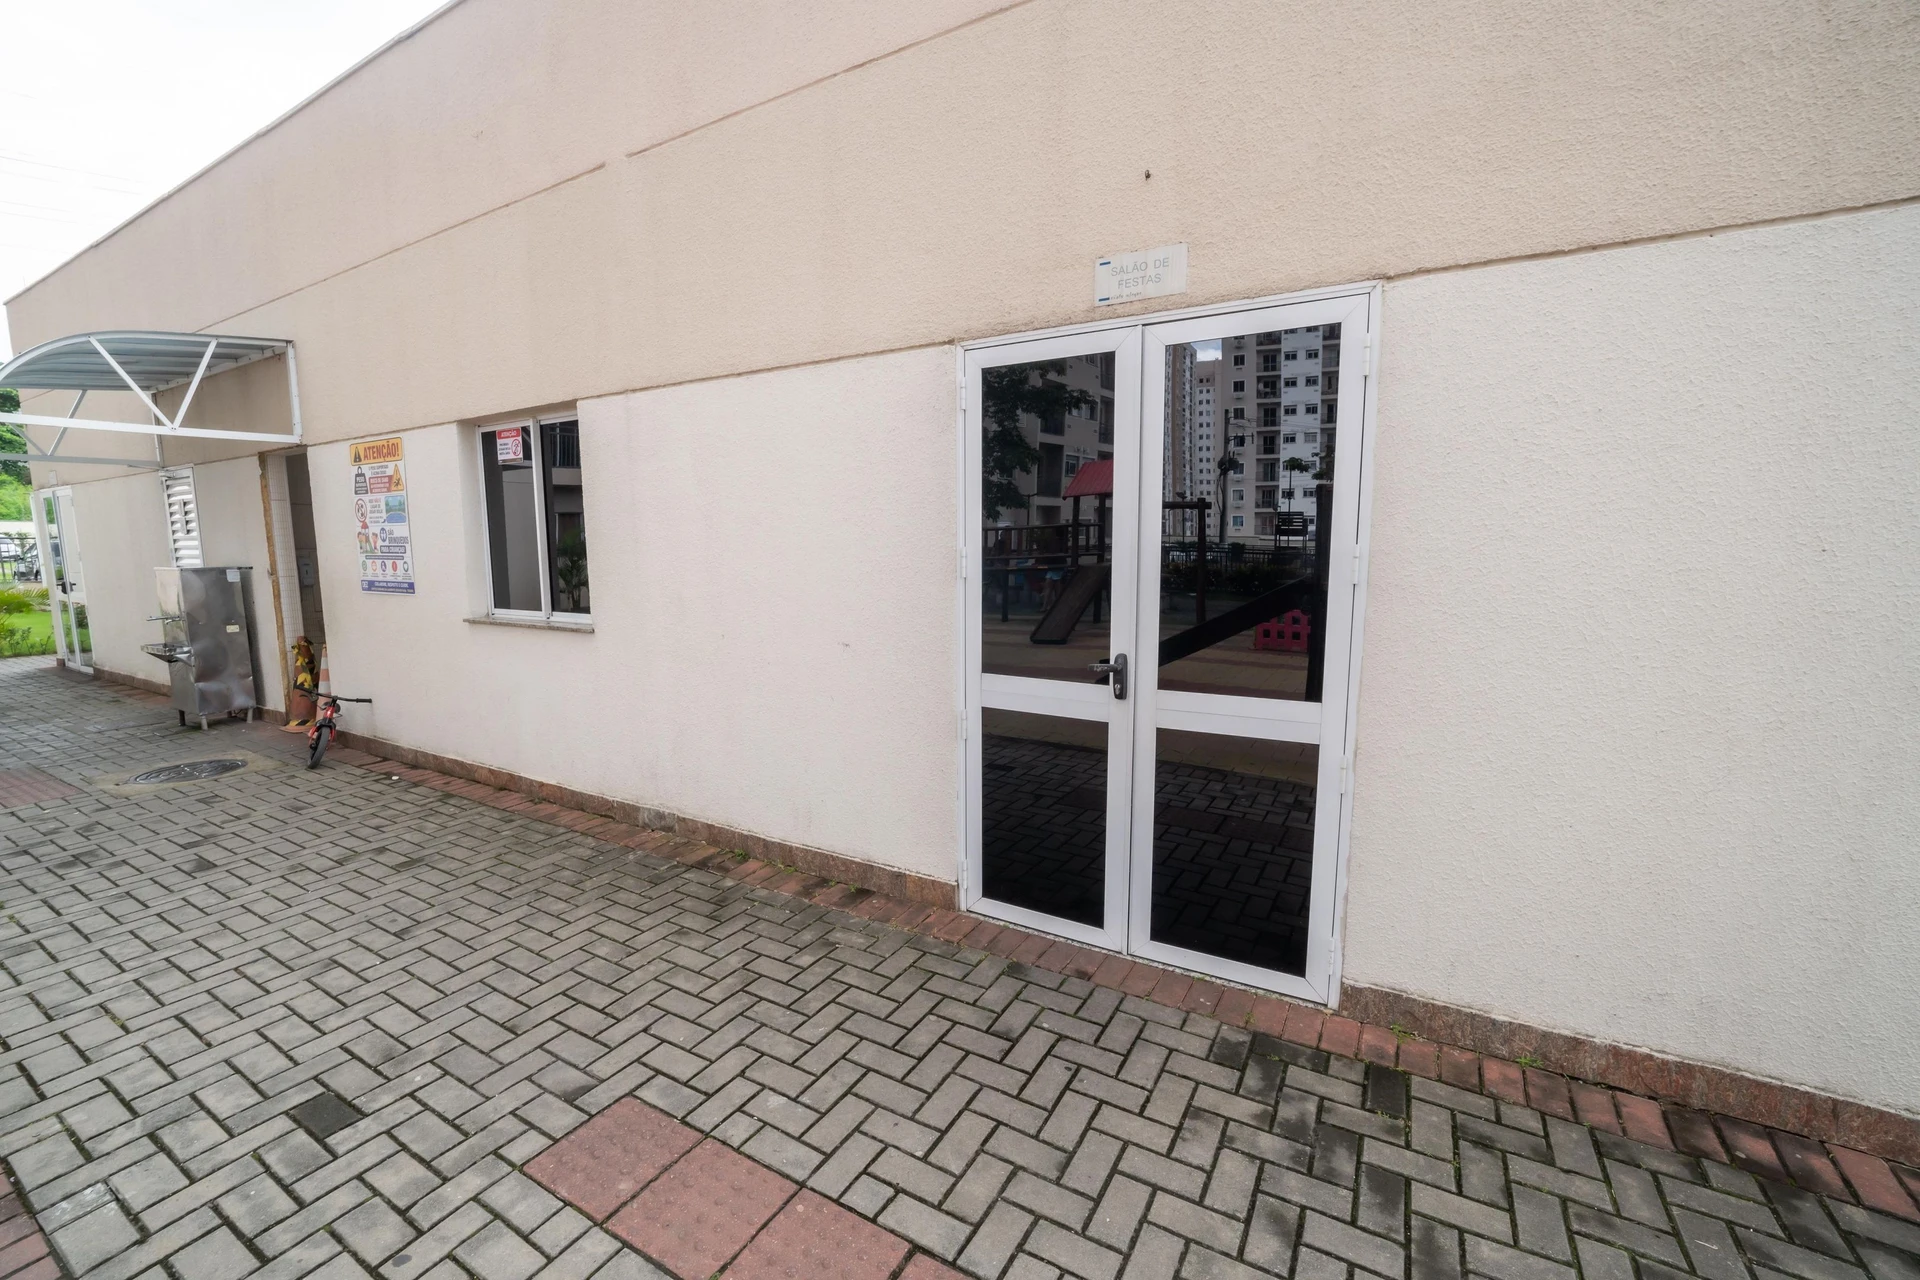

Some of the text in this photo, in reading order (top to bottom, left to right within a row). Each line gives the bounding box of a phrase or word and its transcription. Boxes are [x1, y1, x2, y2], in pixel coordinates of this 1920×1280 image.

[1111, 257, 1169, 276] SALÃO DE
[1118, 273, 1162, 289] FESTAS
[363, 440, 399, 461] ATENÇÃO!
